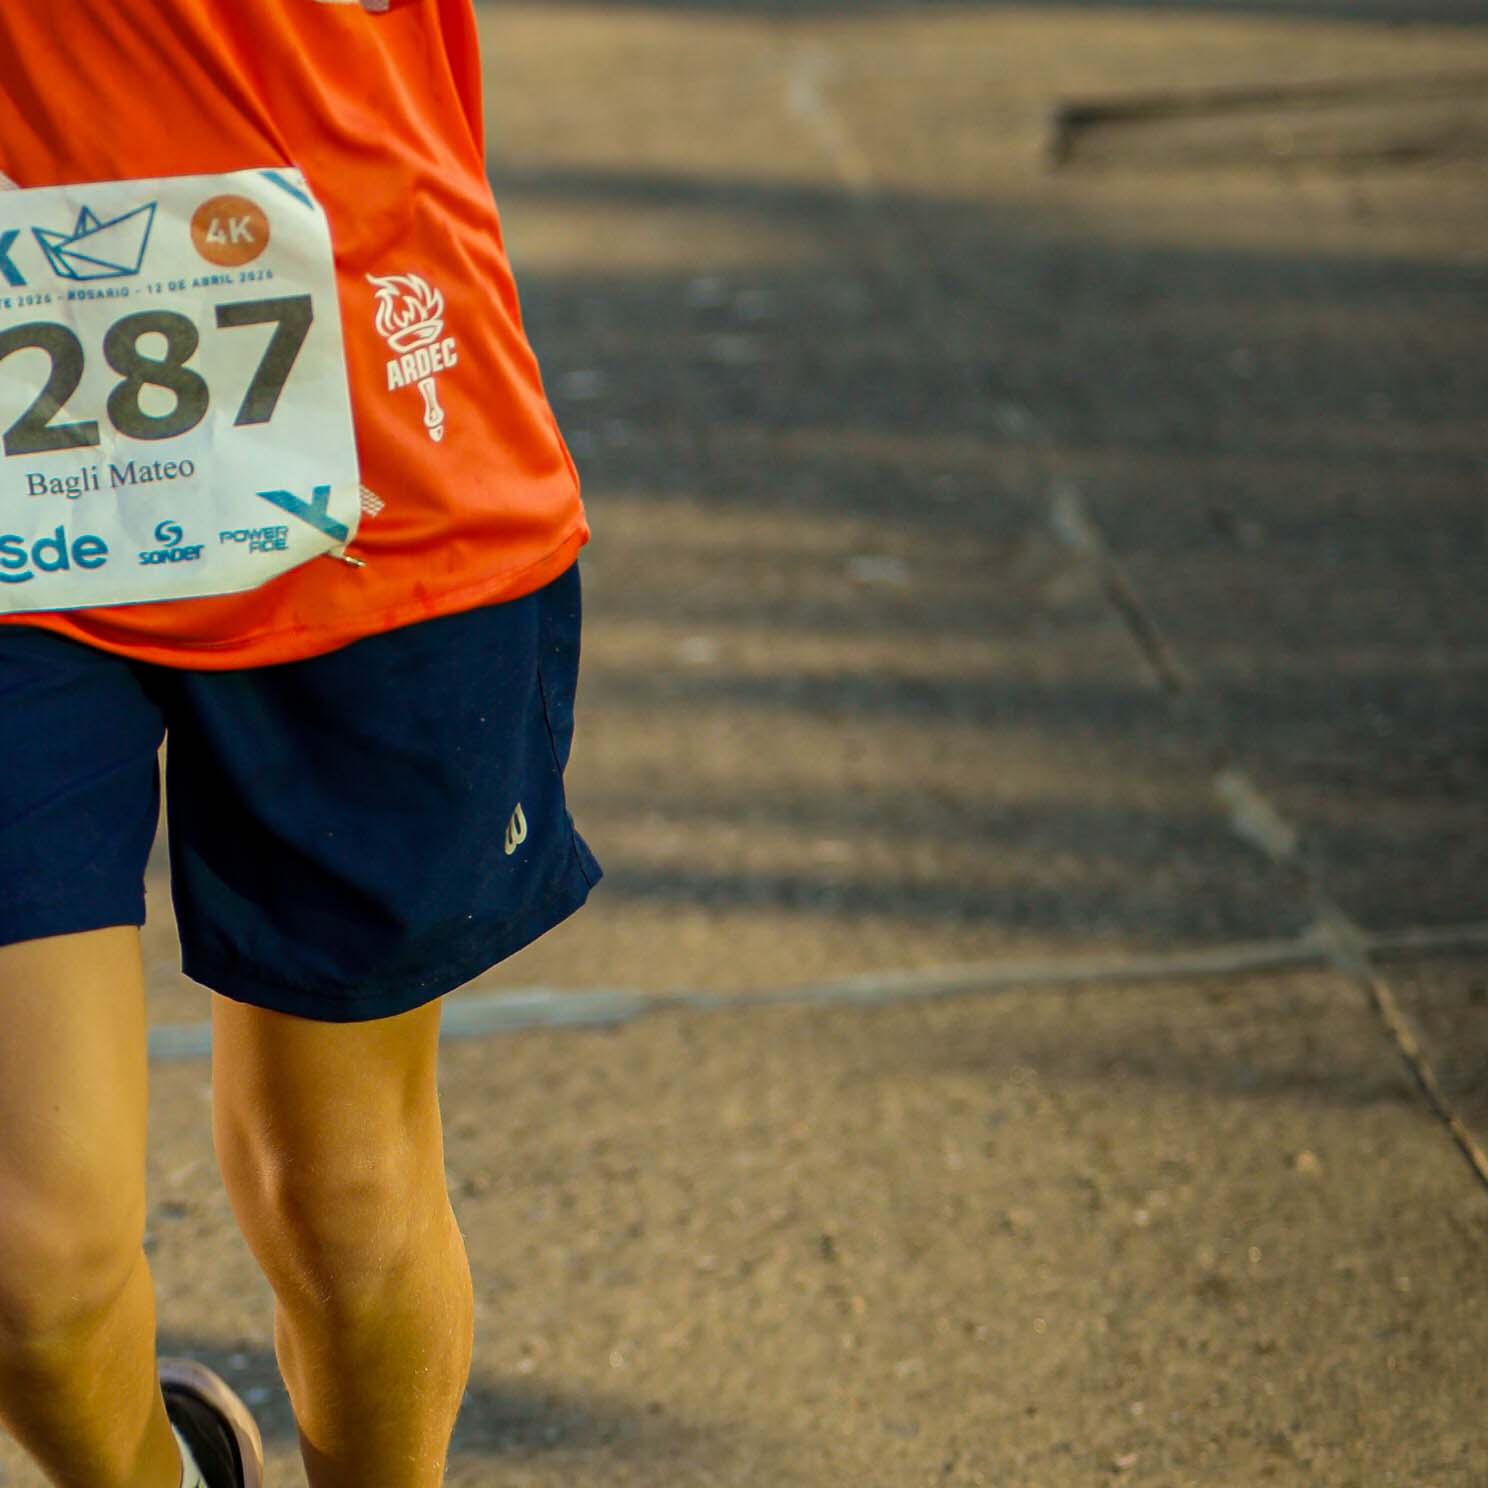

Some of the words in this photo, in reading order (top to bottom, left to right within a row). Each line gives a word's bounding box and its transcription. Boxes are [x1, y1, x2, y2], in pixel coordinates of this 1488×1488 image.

[205, 212, 254, 245] 4K
[17, 294, 53, 308] 2026
[67, 285, 129, 300] ROSARIO
[168, 279, 186, 292] DE
[192, 272, 233, 289] ABRIL
[239, 269, 274, 283] 2026
[386, 337, 458, 392] ARDEC
[25, 468, 99, 500] Bagli
[109, 457, 195, 489] Mateo
[217, 525, 289, 543] POWER
